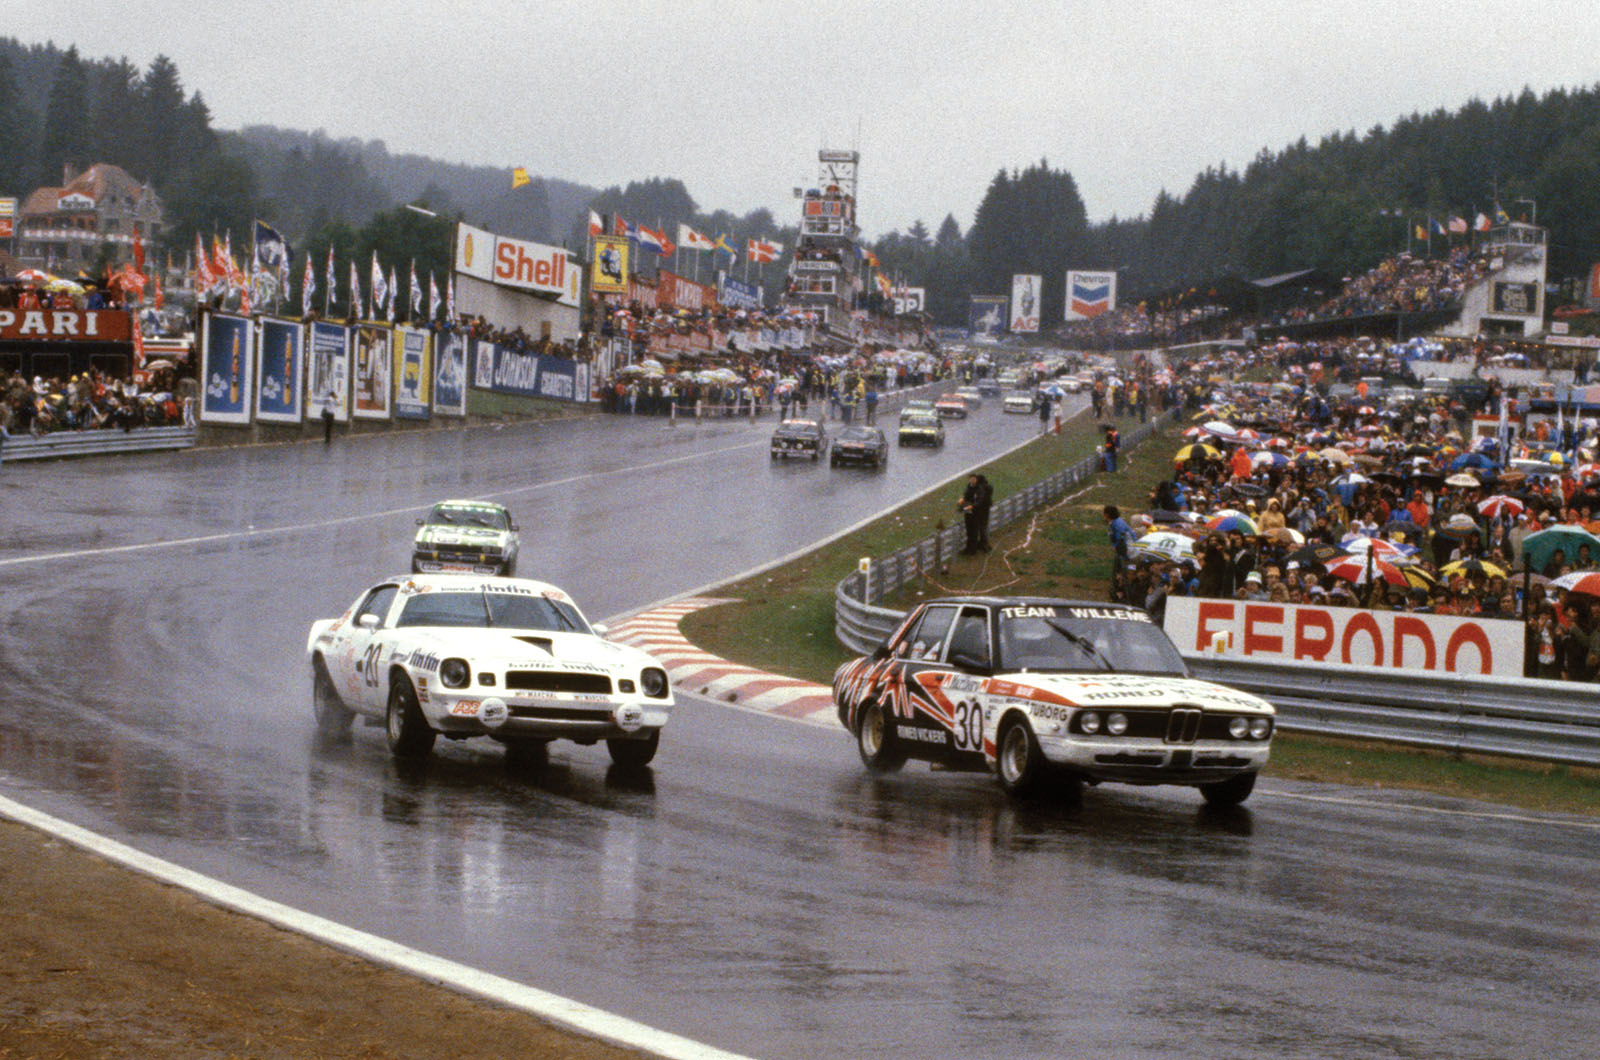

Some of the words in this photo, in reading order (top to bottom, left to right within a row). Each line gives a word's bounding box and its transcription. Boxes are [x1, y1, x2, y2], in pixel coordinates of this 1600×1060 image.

[495, 242, 565, 289] Shell
[1073, 274, 1111, 284] Chevron
[1011, 316, 1039, 330] AC
[1002, 607, 1056, 619] TEAM
[1071, 607, 1153, 624] WILLEME
[1196, 602, 1493, 675] FERODO
[409, 648, 440, 672] tintin
[955, 700, 984, 751] 30
